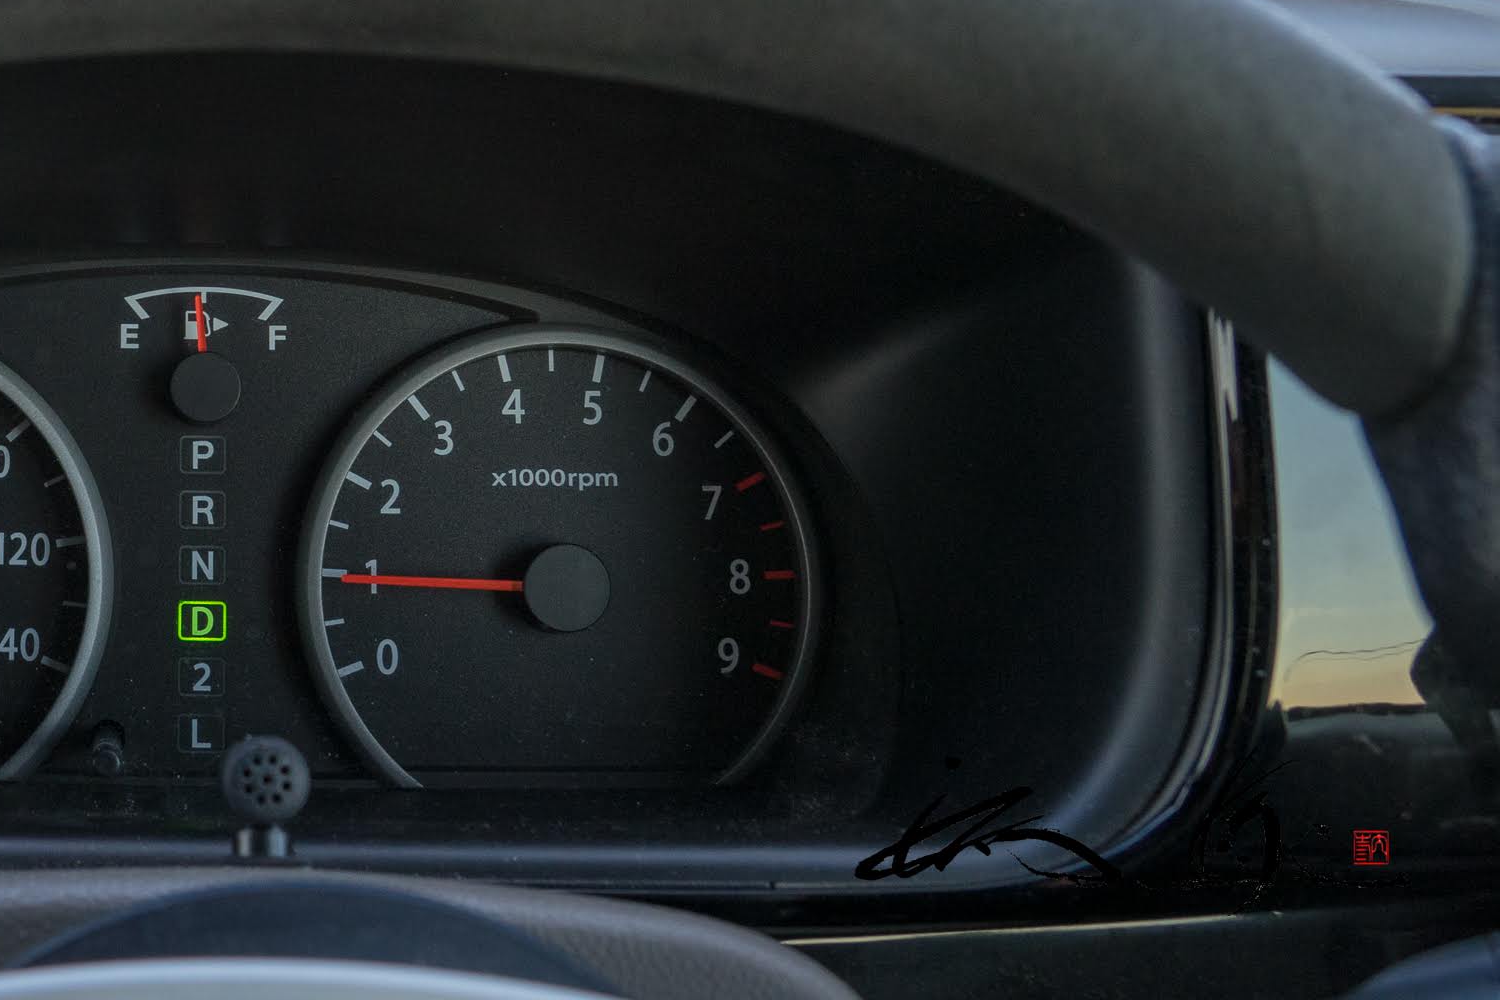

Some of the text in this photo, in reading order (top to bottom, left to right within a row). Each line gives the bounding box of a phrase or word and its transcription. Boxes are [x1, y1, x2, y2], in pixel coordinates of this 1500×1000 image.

[120, 324, 140, 349] E
[269, 326, 287, 350] F
[501, 390, 526, 424] 4
[583, 391, 603, 425] 5
[434, 421, 454, 456] 3
[652, 423, 675, 456] 6
[192, 442, 214, 469] P
[491, 467, 619, 490] x1000rpm
[192, 497, 214, 524] R
[380, 480, 402, 514] 2
[701, 485, 723, 520] 7
[191, 552, 214, 579] N
[364, 559, 378, 594] 1
[729, 560, 751, 594] 8
[192, 607, 214, 635] D
[376, 639, 399, 675] 0
[717, 638, 740, 673] 9
[192, 663, 211, 690] 2
[191, 719, 211, 748] L
